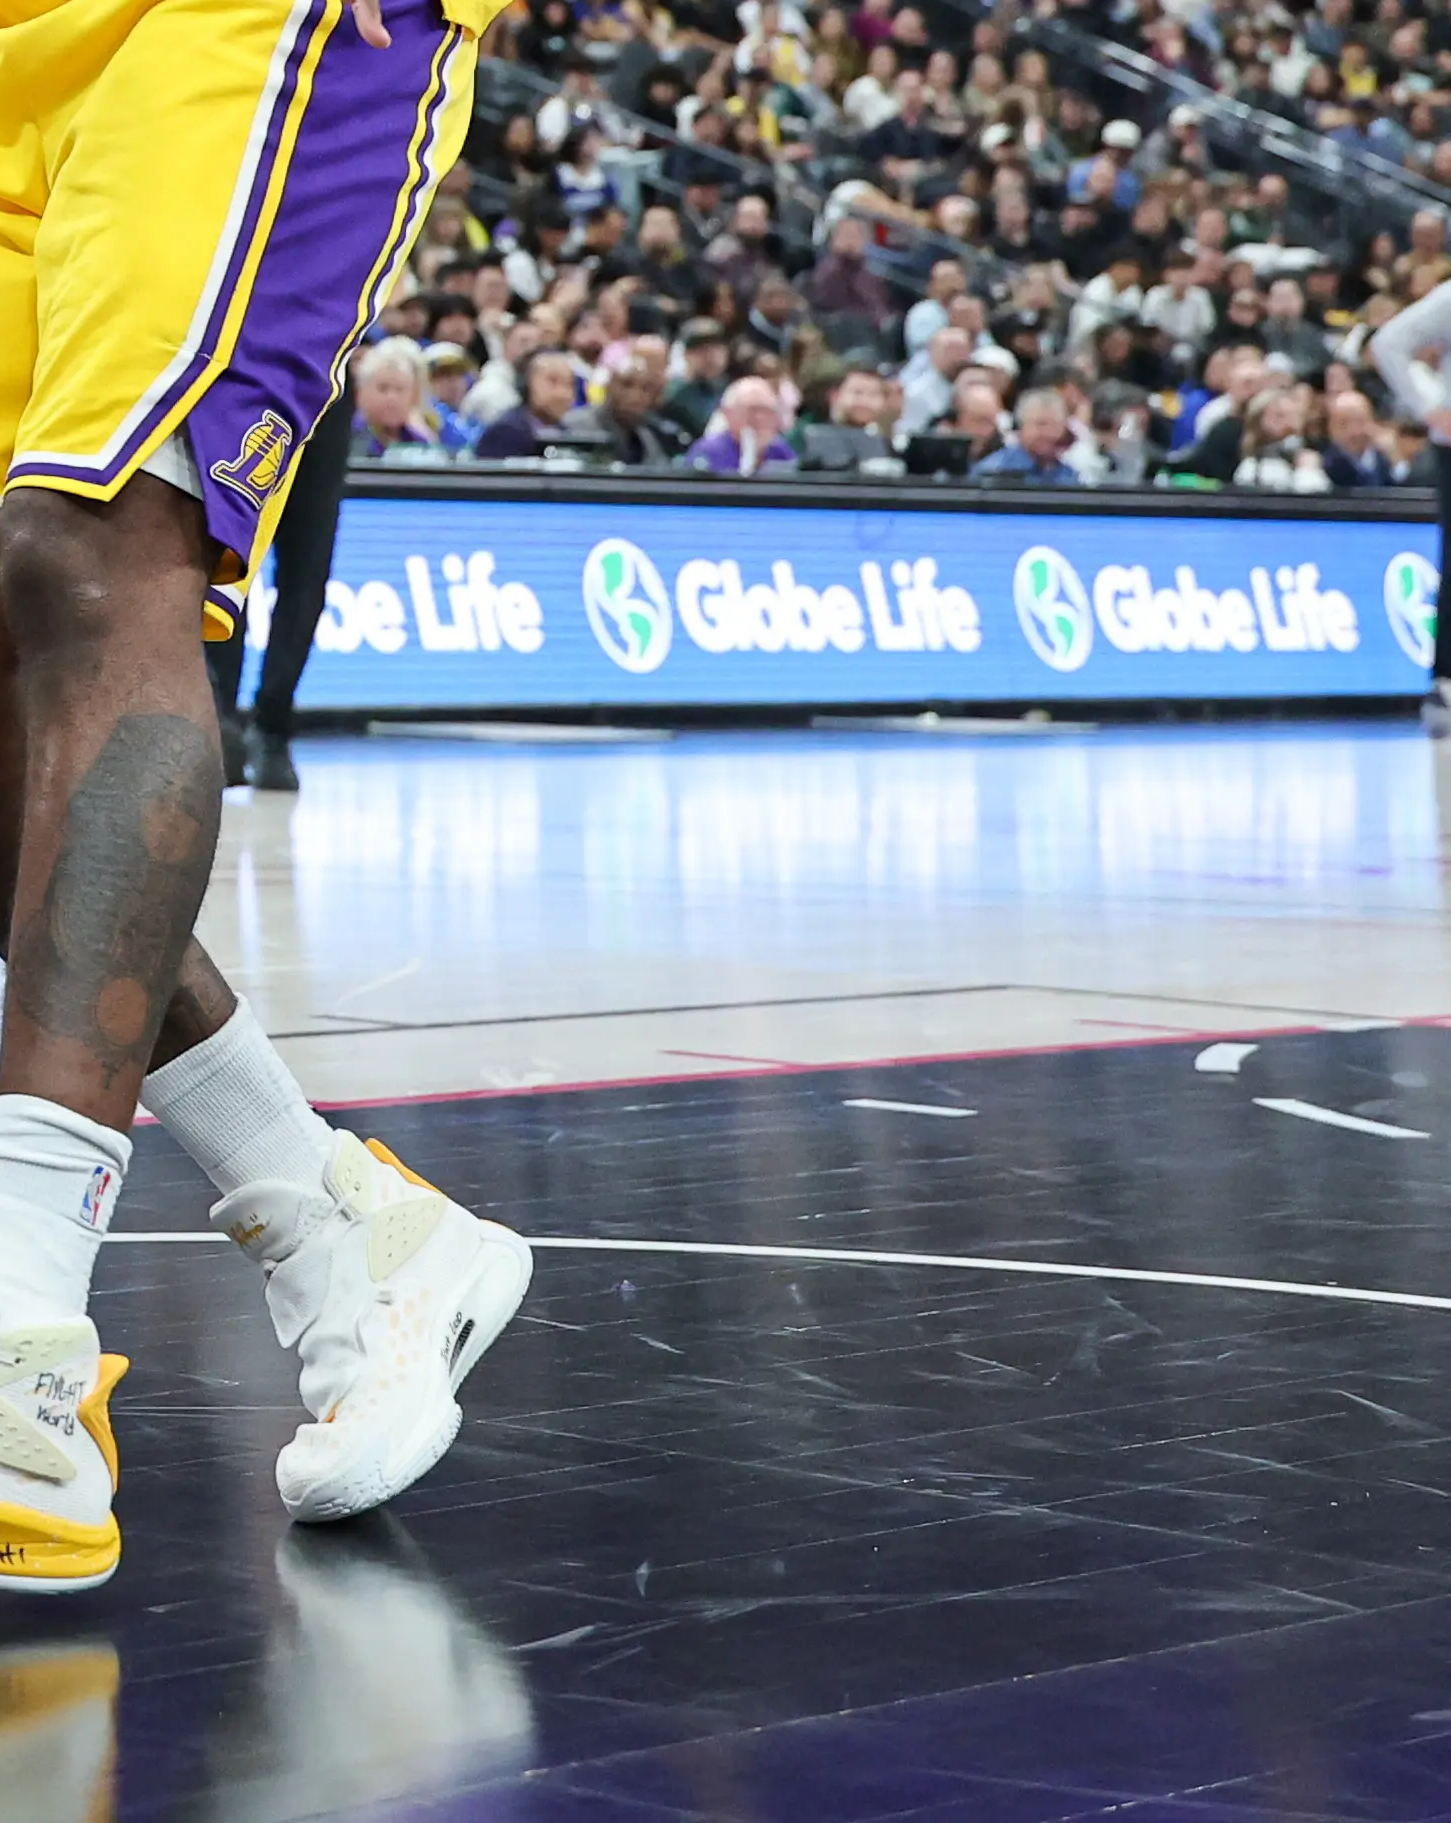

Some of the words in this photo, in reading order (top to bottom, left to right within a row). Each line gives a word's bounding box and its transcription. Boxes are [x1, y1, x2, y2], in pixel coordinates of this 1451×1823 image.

[404, 550, 546, 654] Life
[675, 557, 866, 654] Globe
[858, 556, 982, 654] Life
[1093, 563, 1260, 653] Globe
[1249, 561, 1361, 653] Life
